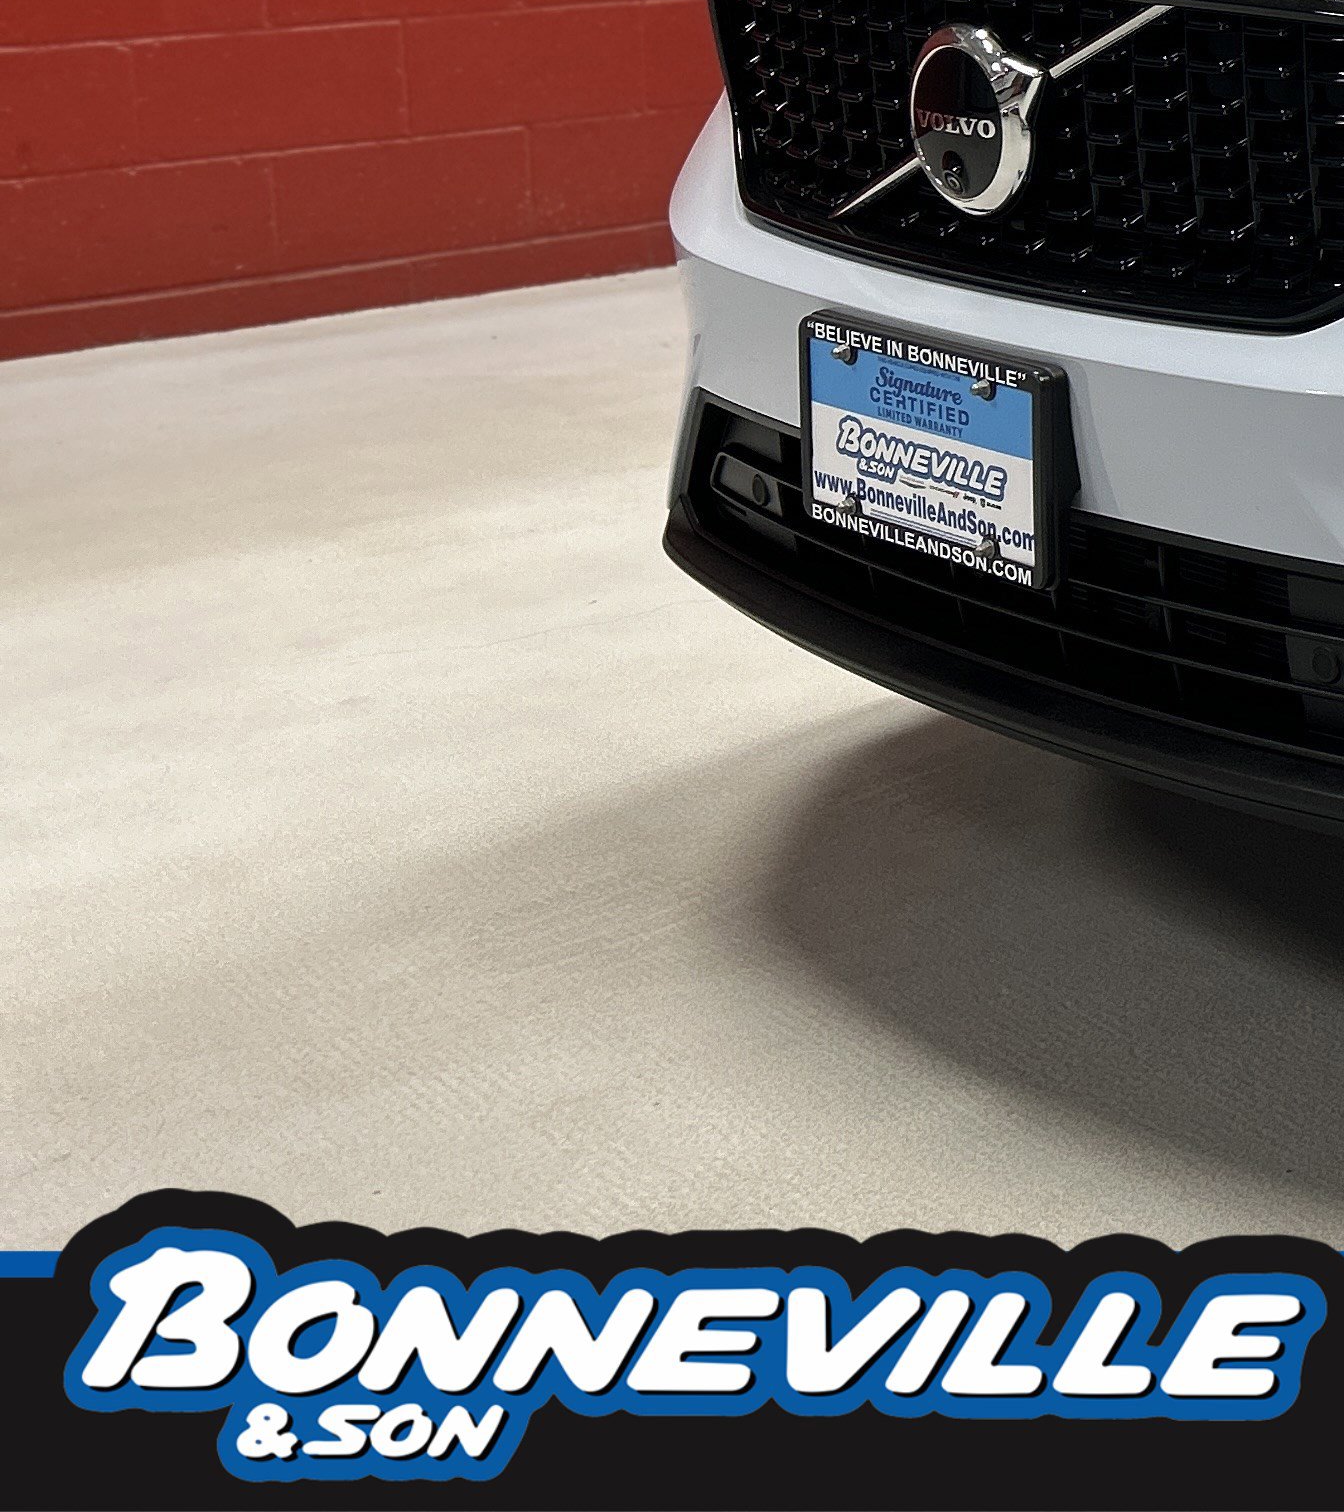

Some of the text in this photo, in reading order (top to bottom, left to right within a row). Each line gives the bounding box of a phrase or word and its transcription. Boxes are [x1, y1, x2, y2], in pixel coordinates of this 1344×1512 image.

[915, 107, 996, 139] VOLVO
[886, 338, 904, 359] IN
[875, 366, 963, 406] Signature
[869, 387, 970, 426] CERTIFIED
[877, 406, 964, 438] LIMITED WARRANTY
[838, 417, 1006, 496] BONNEVILLE
[811, 503, 1033, 586] BONNEVILLEANDSON.COM
